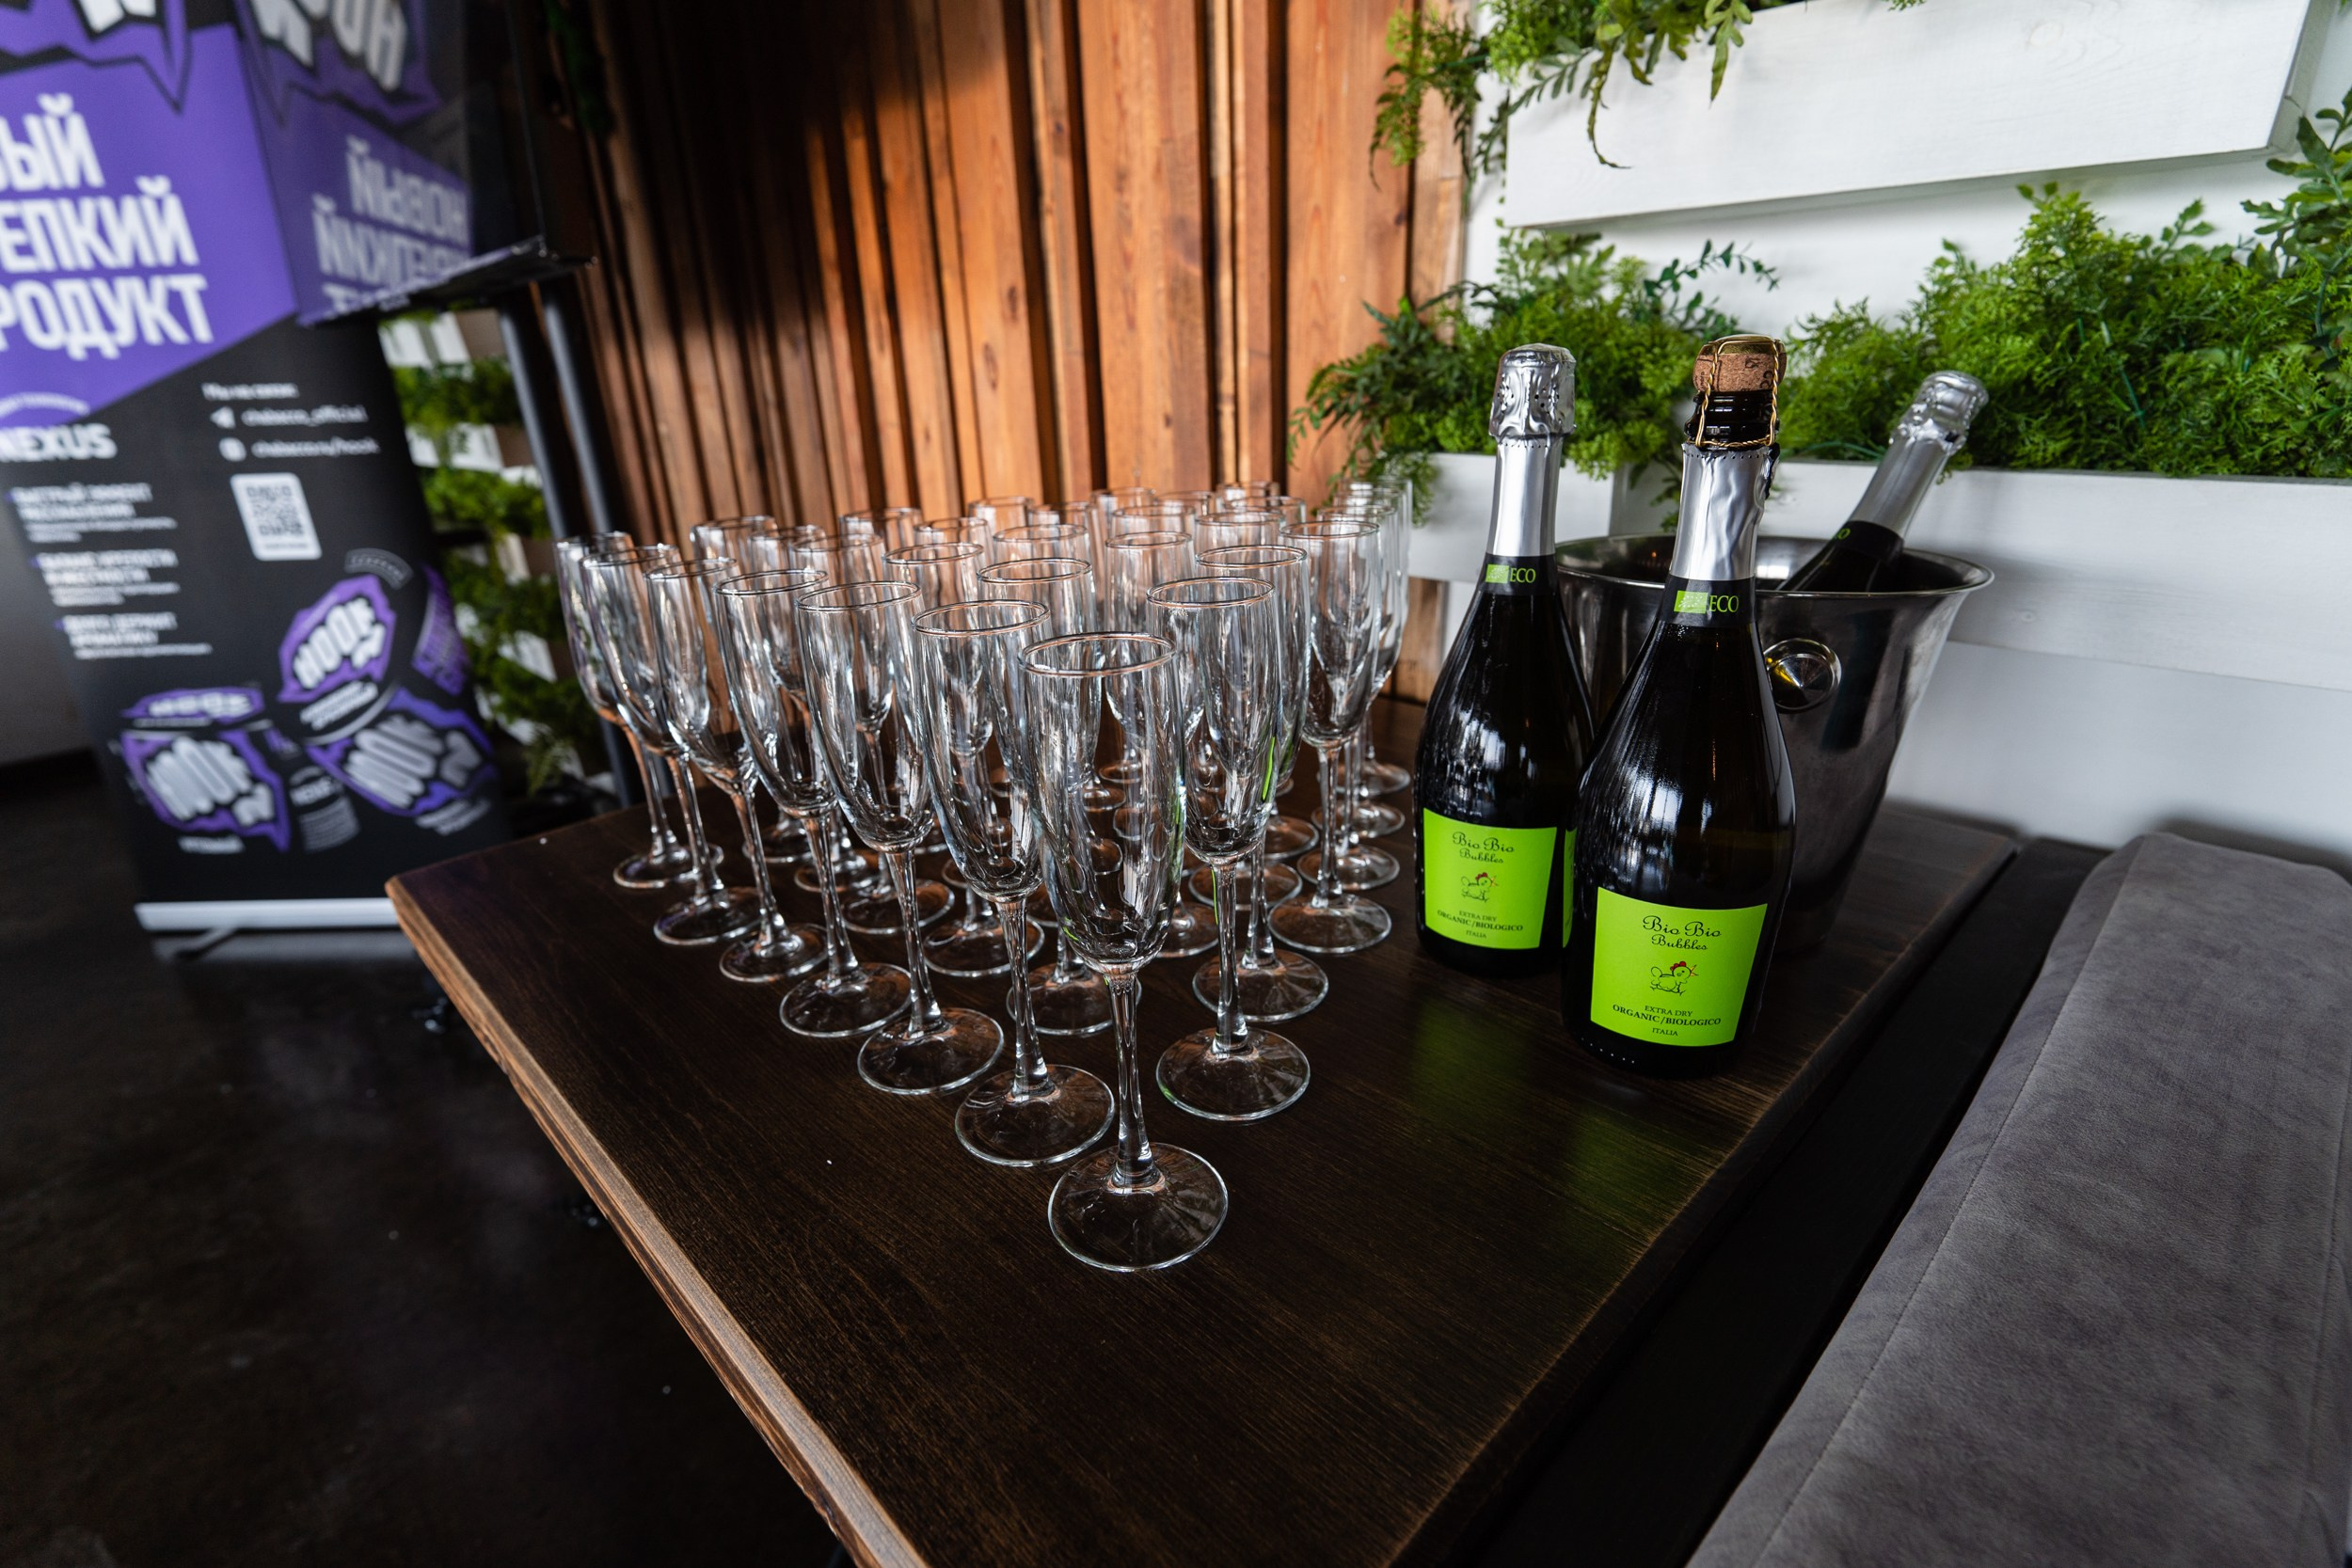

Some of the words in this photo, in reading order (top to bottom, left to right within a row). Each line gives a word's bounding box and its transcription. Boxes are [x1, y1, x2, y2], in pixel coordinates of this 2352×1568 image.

[1510, 567, 1536, 583] ECO
[1708, 594, 1740, 612] ECO
[1453, 832, 1481, 849] Bio
[1484, 837, 1515, 853] Bio
[1459, 848, 1504, 863] Bubbles
[1459, 911, 1481, 921] EXTRA
[1466, 929, 1487, 939] ITALIA
[1643, 915, 1680, 935] Bio
[1684, 921, 1723, 938] Bio
[1651, 934, 1708, 951] Bubbles
[1645, 1005, 1673, 1016] EXTRA
[1652, 1027, 1678, 1037] ITALIA
